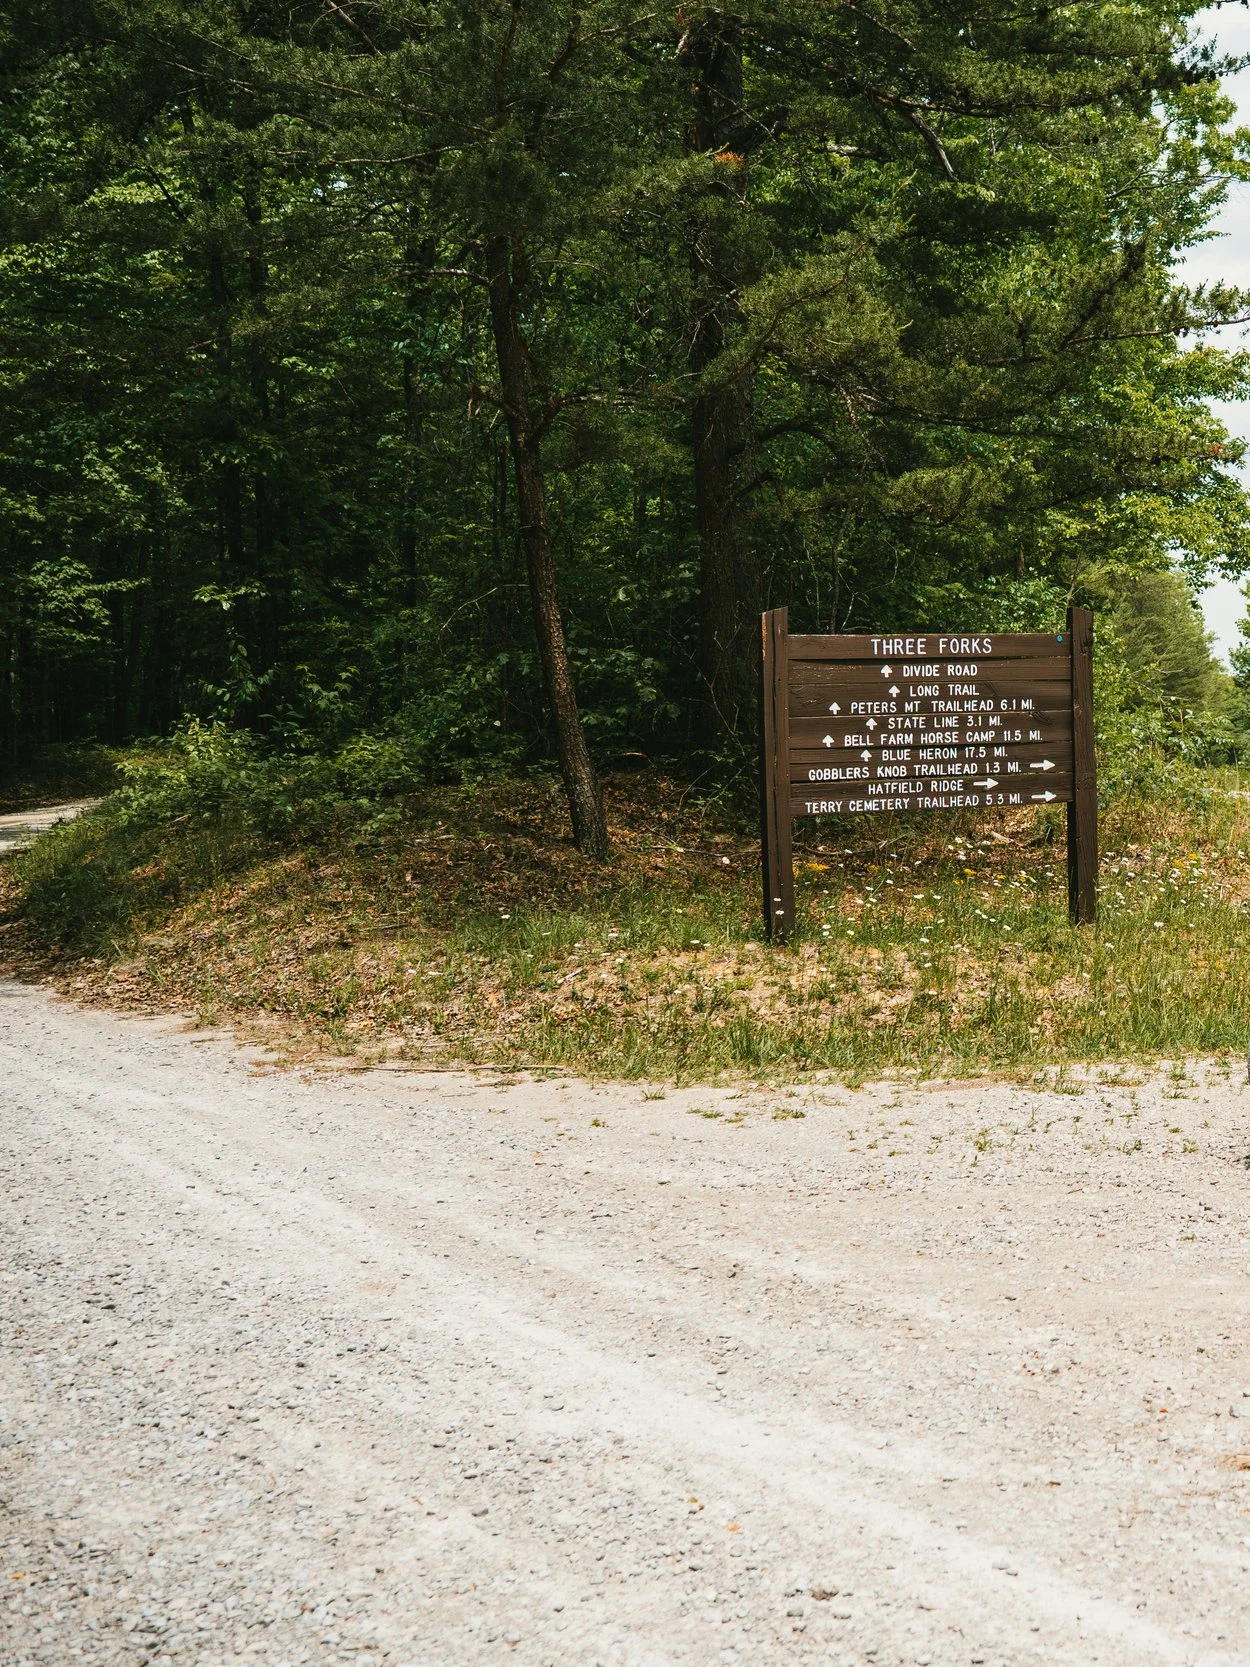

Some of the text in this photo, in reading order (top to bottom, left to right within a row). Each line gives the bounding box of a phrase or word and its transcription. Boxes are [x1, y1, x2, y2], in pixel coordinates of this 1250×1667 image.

[871, 638, 991, 655] THREE FORKS
[903, 665, 977, 677] DIVIDE ROAD
[910, 684, 979, 696] LONG TRAIL
[851, 699, 1035, 714] PETERS MT TRAILHEAD 6.1 MI.
[888, 716, 1003, 729] STATE LINE 3.1 MI.
[845, 730, 1043, 746] BELL FARM HORSE CAMP 11.5 MI.
[882, 746, 1008, 761] BLUE HERON 17.5 MI.
[809, 762, 1022, 780] GOBBLERS KNOB TRAILHEAD 1.3 MI.
[869, 780, 963, 794] HATFIELD RIDGE
[805, 801, 842, 813] TERRY
[849, 798, 909, 811] CEMETERY
[917, 795, 979, 808] TRAILHEAD
[1010, 793, 1023, 804] MI.
